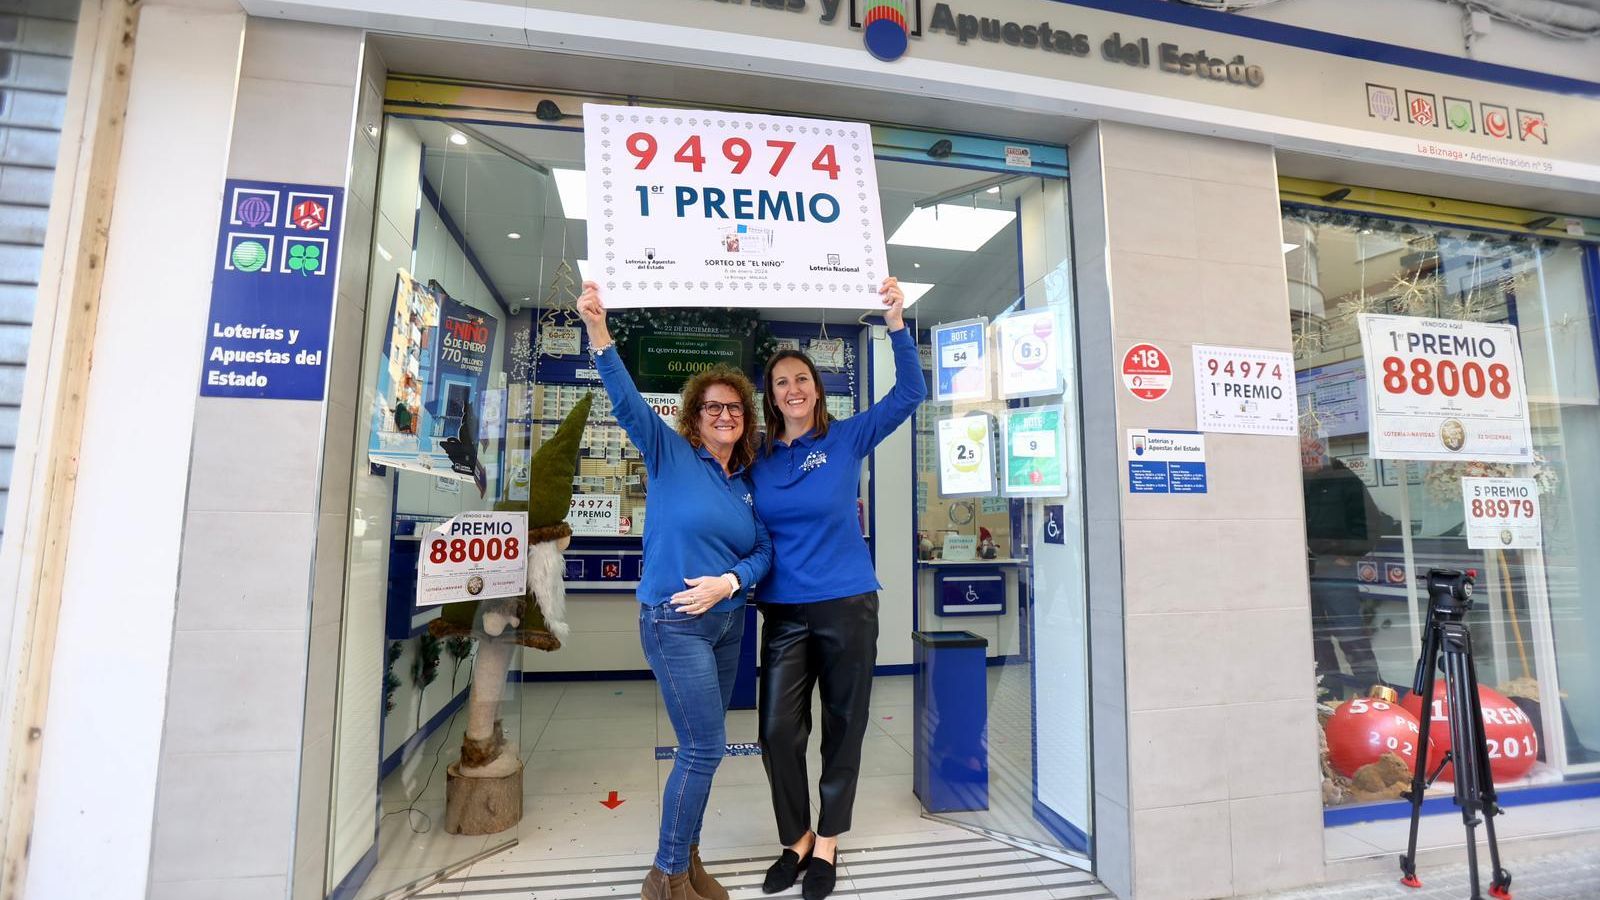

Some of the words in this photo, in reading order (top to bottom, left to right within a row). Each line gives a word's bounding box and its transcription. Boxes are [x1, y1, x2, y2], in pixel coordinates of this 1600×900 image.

[928, 2, 1091, 57] Apuestas
[1100, 31, 1150, 68] del
[1158, 42, 1264, 88] Estado
[626, 132, 841, 180] 94974
[1417, 143, 1428, 154] La
[1429, 145, 1463, 161] Biznaga
[635, 184, 665, 217] 1er
[675, 185, 841, 224] PREMIO
[704, 259, 734, 267] SORTEO
[748, 259, 760, 267] "EL
[761, 259, 785, 268] NIÑO"
[213, 322, 284, 341] Loterías
[288, 328, 300, 344] y
[453, 320, 489, 345] NIÑO
[684, 326, 719, 334] DICIEMBRE
[1421, 321, 1447, 329] VENDIDO
[443, 332, 452, 347] 6
[452, 338, 463, 349] DE
[463, 340, 487, 354] ENERO
[951, 330, 968, 341] BOTE
[441, 347, 461, 362] 770
[1407, 332, 1496, 359] PREMIO
[210, 346, 290, 366] Apuestas
[295, 350, 322, 366] del
[953, 351, 967, 361] 54
[1131, 349, 1160, 368] +18
[1207, 358, 1283, 381] 94974
[1383, 356, 1512, 399] 88008
[207, 370, 268, 388] Estado
[1224, 383, 1282, 400] PREMIO
[1030, 440, 1038, 451] 9
[1484, 486, 1529, 498] PREMIO
[570, 499, 613, 509] 94974
[1471, 499, 1534, 518] 88979
[577, 510, 612, 518] PREMIO
[451, 521, 513, 536] PREMIO
[429, 537, 519, 564] 88008
